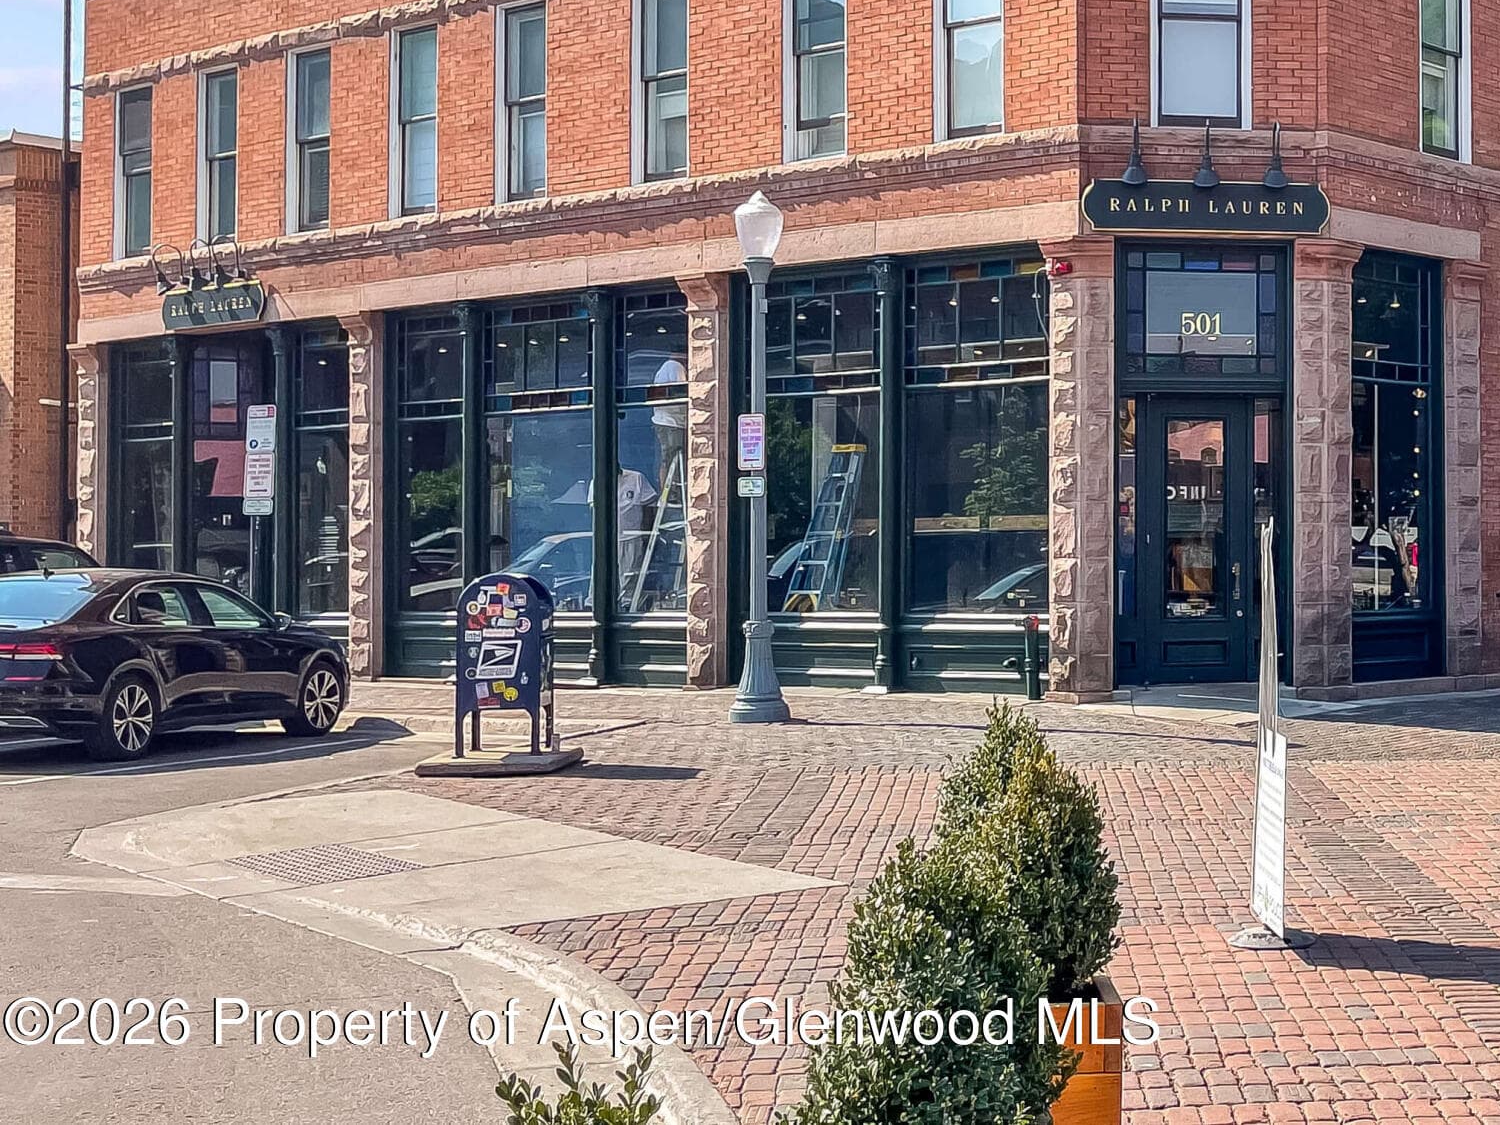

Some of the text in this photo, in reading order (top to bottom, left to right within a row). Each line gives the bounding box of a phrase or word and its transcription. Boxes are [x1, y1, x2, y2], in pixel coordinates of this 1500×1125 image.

[1109, 197, 1304, 216] RALPH LAUREN
[1181, 312, 1222, 336] 501
